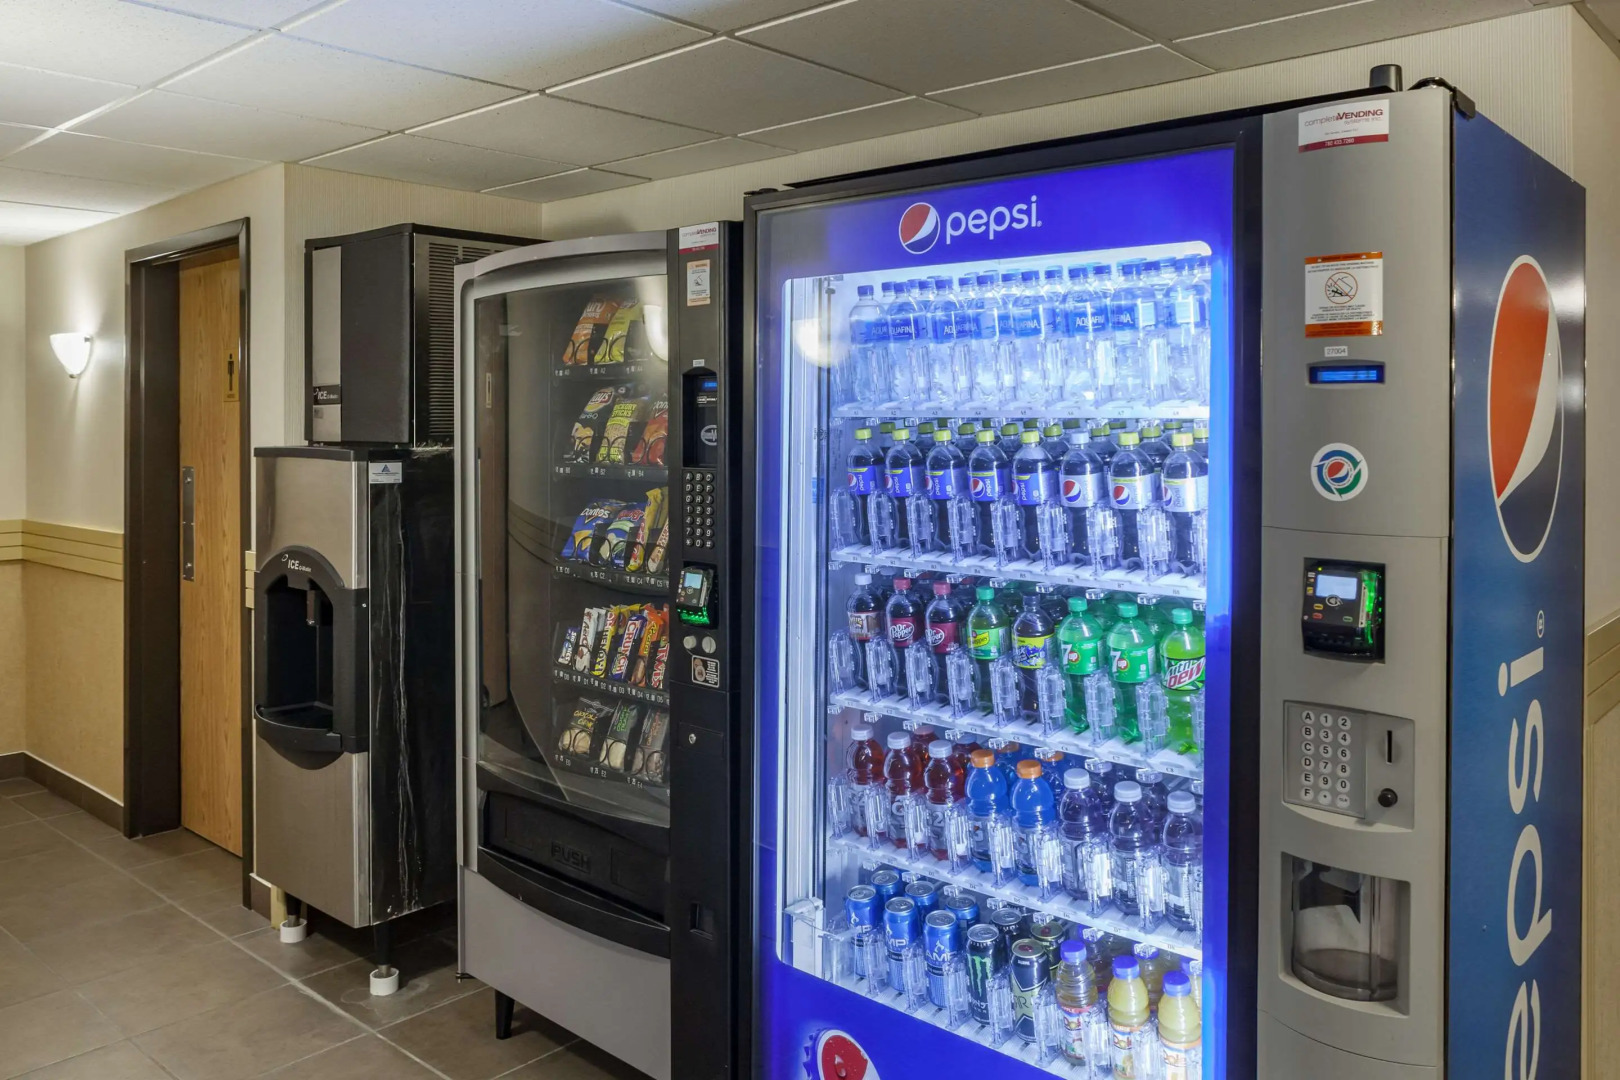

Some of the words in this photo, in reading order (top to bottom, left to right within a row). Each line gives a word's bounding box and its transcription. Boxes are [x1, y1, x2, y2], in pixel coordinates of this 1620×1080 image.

[946, 195, 1037, 245] pepsi
[1019, 482, 1028, 501] pepsi
[580, 507, 611, 520] Doritos
[287, 559, 300, 570] ICE
[896, 623, 907, 632] Dr
[1304, 712, 1312, 720] A
[1341, 718, 1347, 726] 2
[1323, 731, 1329, 740] 3
[1341, 734, 1348, 742] 4
[1304, 743, 1311, 752] C
[1322, 746, 1329, 754] 5
[1322, 777, 1329, 786] 9
[551, 841, 592, 875] PUSH
[1497, 646, 1552, 1080] epsi
